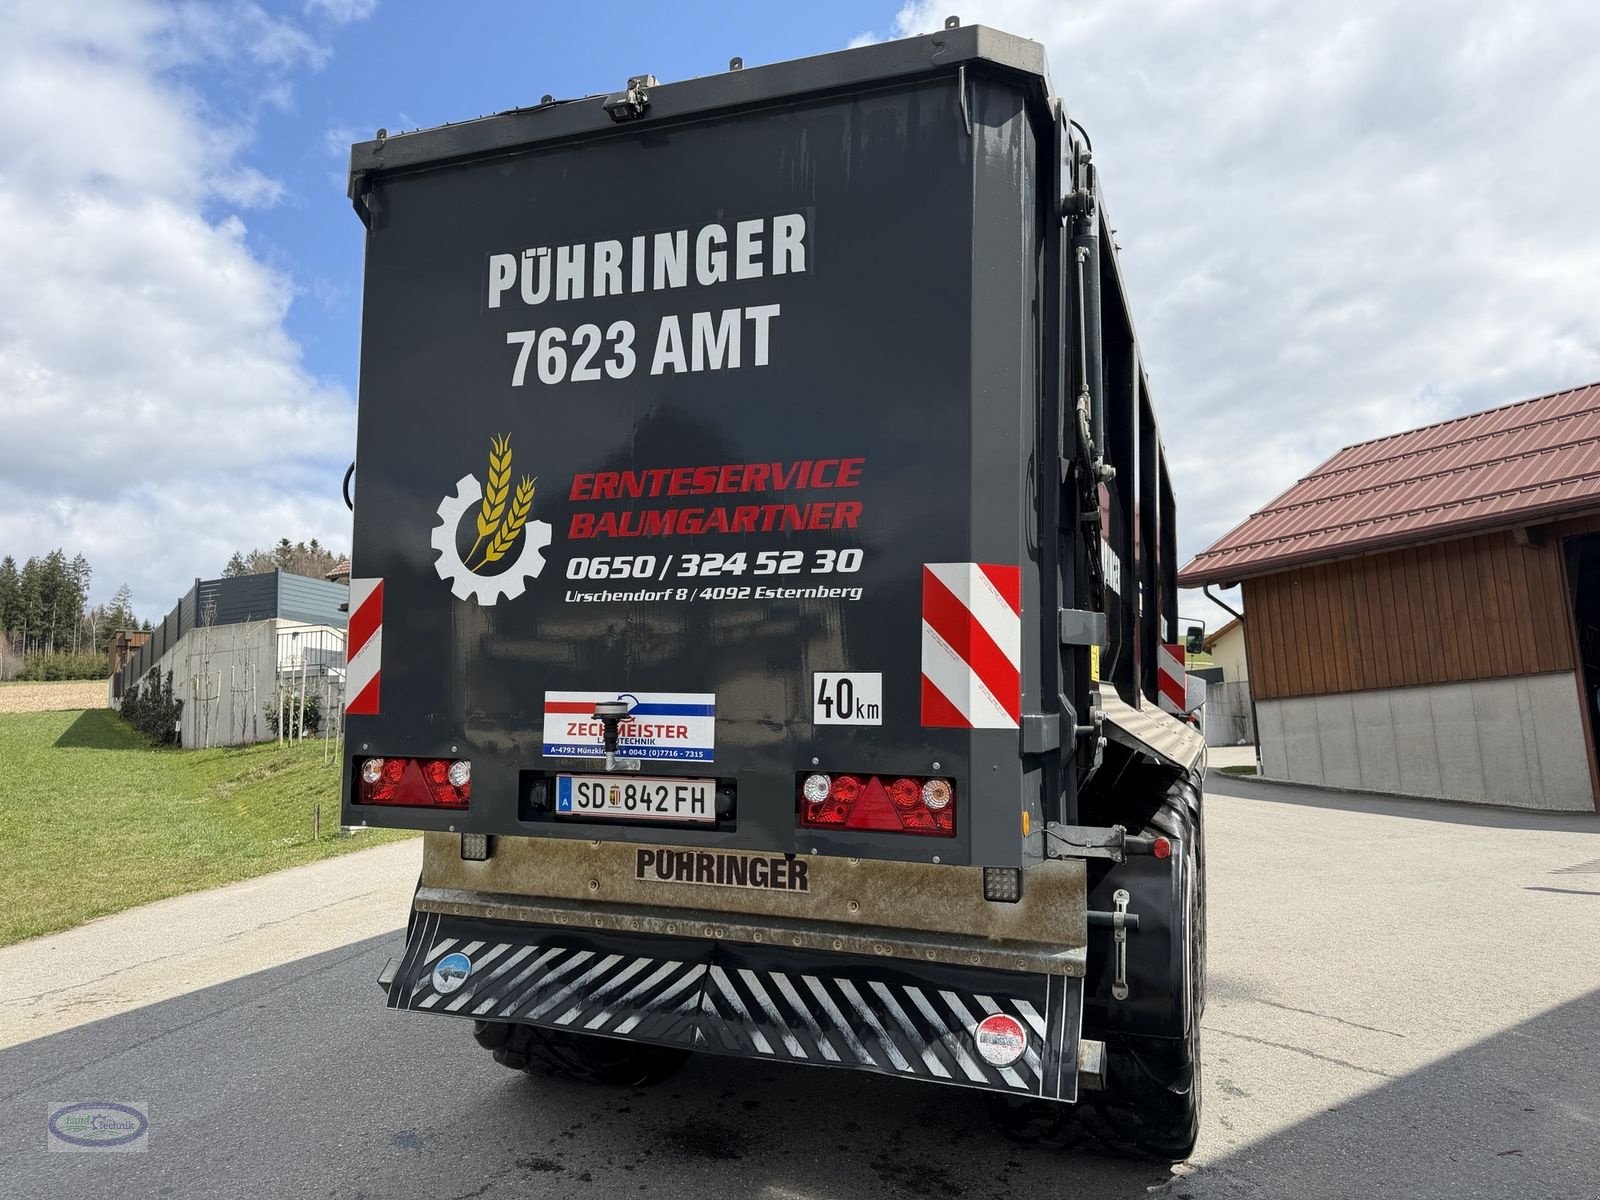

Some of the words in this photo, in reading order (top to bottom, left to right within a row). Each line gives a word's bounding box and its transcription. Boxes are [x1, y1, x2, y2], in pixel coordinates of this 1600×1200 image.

[488, 213, 807, 309] PÜHRINGER
[506, 320, 637, 387] 7623
[650, 304, 781, 375] AMT
[569, 457, 866, 501] ERNTESERVICE
[567, 501, 864, 540] BAUMGARTNER
[566, 555, 656, 580] 0650
[677, 552, 748, 577] 324
[753, 550, 804, 575] 52
[811, 548, 864, 574] 30
[565, 588, 674, 603] Urschendorf
[675, 588, 688, 601] 8
[699, 586, 751, 600] 4092
[754, 585, 863, 601] Esternberg
[550, 746, 576, 754] A-4792
[648, 749, 678, 757] (0)7716
[685, 750, 704, 758] 7315
[597, 737, 656, 745] LTECHNIK
[562, 798, 569, 807] A
[577, 782, 605, 808] SD
[636, 848, 808, 891] PÜHRINGER
